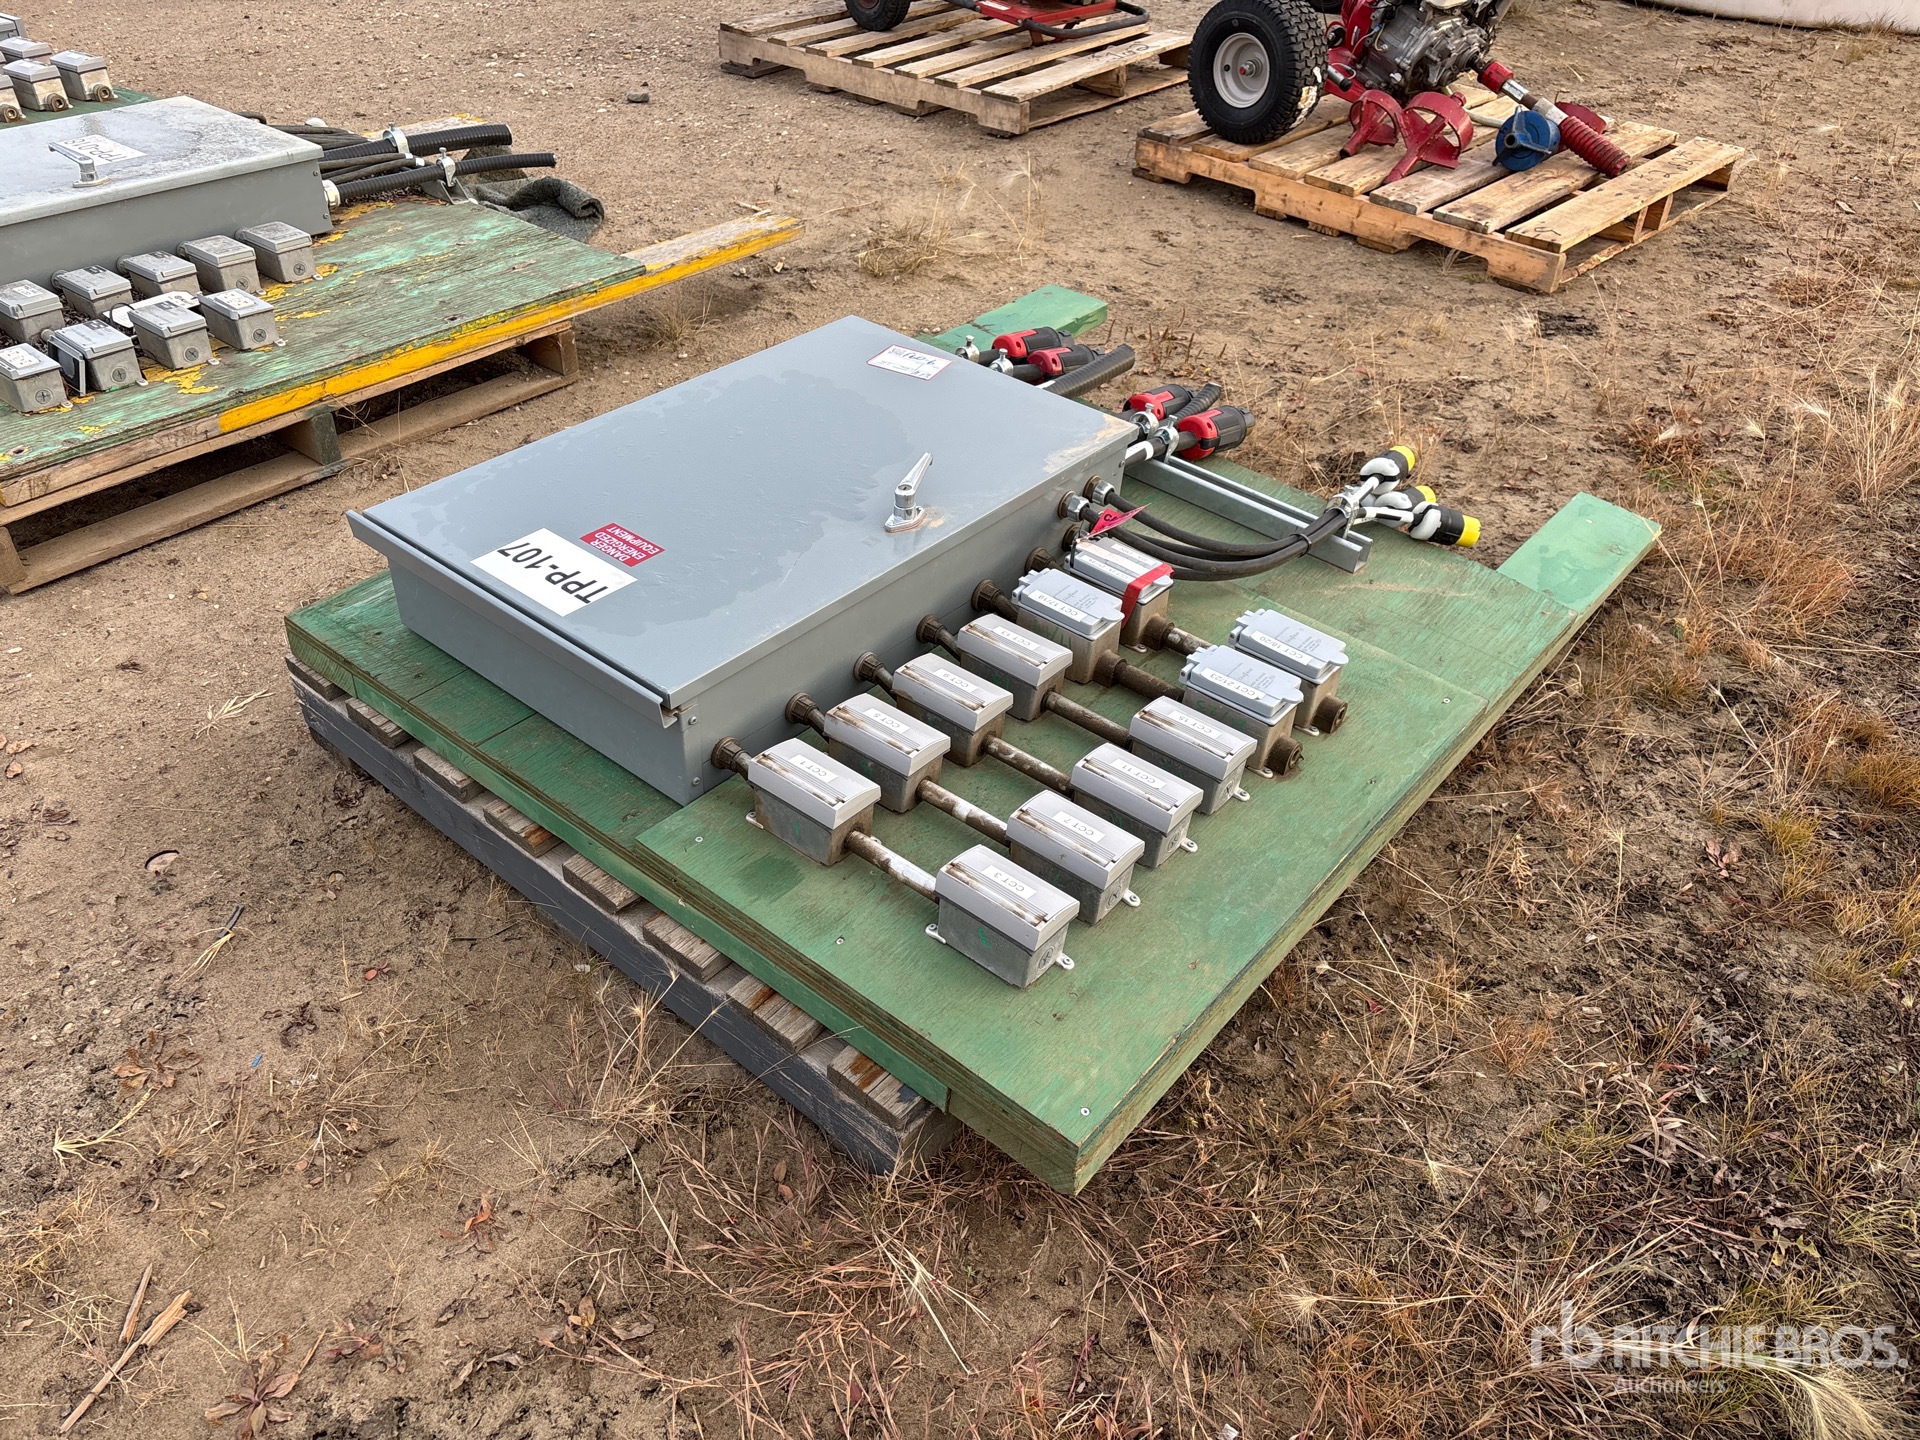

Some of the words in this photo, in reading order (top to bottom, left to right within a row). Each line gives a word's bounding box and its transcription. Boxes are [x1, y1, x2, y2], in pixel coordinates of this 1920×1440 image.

[594, 532, 648, 560] ENERGIZED
[606, 526, 660, 554] EQUIPMENT
[589, 540, 626, 562] DANGER
[496, 541, 609, 604] TPP-107
[1037, 594, 1059, 607] 17/19
[1060, 605, 1078, 617] CCT
[1010, 635, 1031, 647] CCT
[1259, 636, 1282, 650] 18/20
[1282, 647, 1303, 660] CCT
[949, 677, 969, 688] CCT
[1209, 673, 1235, 687] 21/23
[1235, 684, 1256, 697] CCT
[879, 717, 900, 729] CCT
[1190, 721, 1212, 734] CCT
[805, 765, 827, 778] CCT
[1122, 765, 1134, 773] 11
[1134, 771, 1156, 785] CCT
[1072, 823, 1094, 836] CCT
[1001, 878, 1025, 893] CCT
